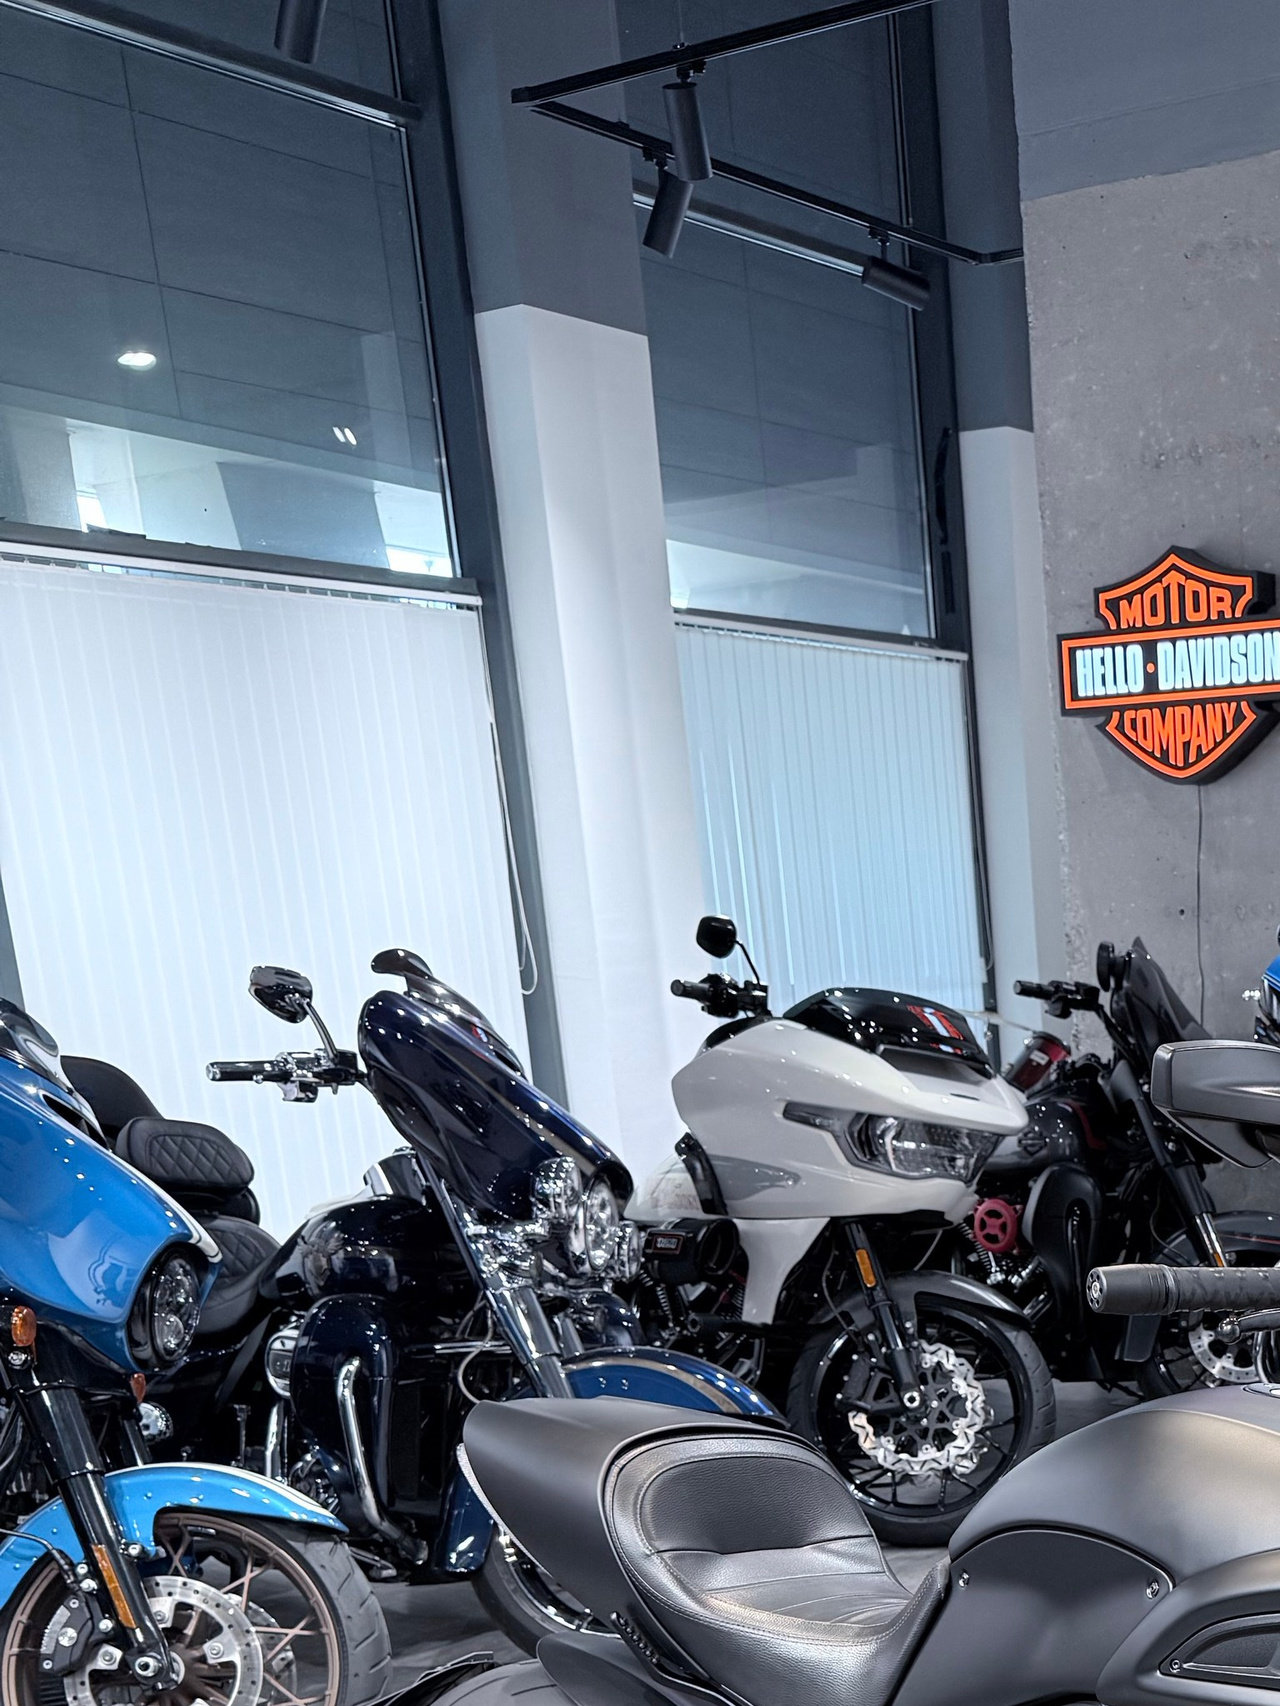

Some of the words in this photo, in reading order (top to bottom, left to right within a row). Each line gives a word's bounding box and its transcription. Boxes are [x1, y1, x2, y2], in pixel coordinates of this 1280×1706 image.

[1119, 569, 1232, 629] MOTOR
[1075, 644, 1144, 697] HELLO
[1123, 701, 1238, 767] COMPANY
